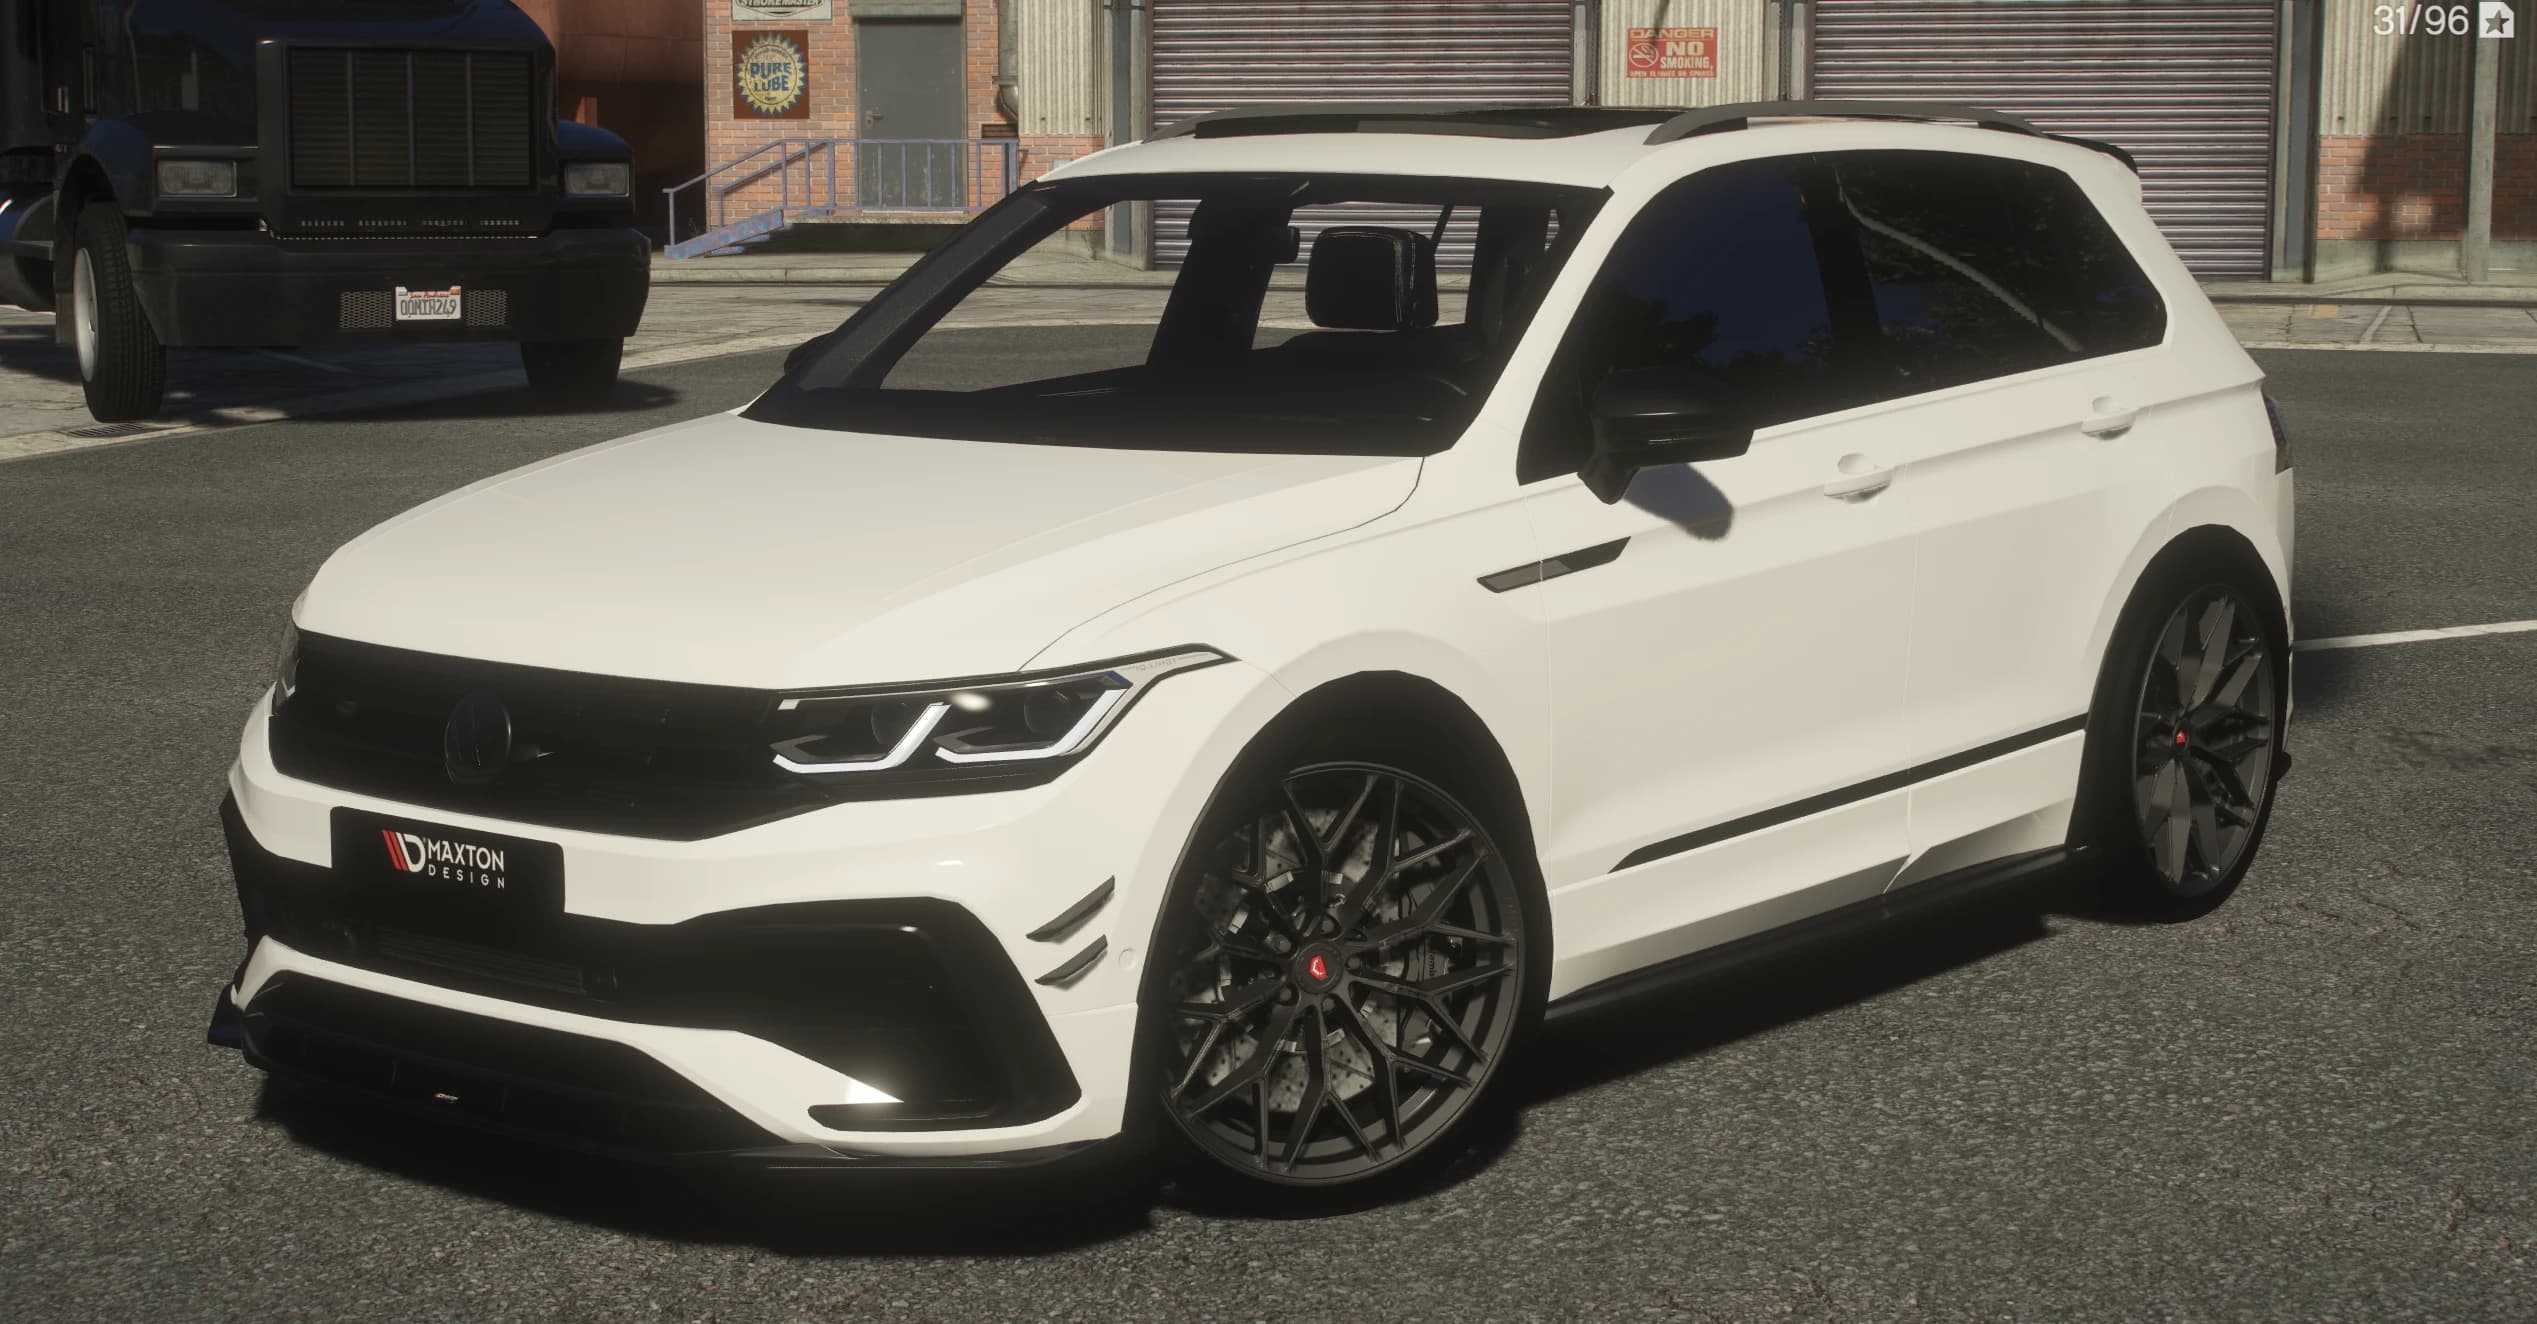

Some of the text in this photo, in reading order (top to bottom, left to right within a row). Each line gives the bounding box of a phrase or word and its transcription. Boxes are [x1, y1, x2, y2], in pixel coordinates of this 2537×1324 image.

[1630, 29, 1714, 39] DANGER
[1665, 41, 1704, 56] NO
[750, 62, 792, 79] PURE
[753, 75, 789, 92] LUBE
[427, 838, 504, 872] MAXTON
[428, 863, 505, 889] DESIGN
